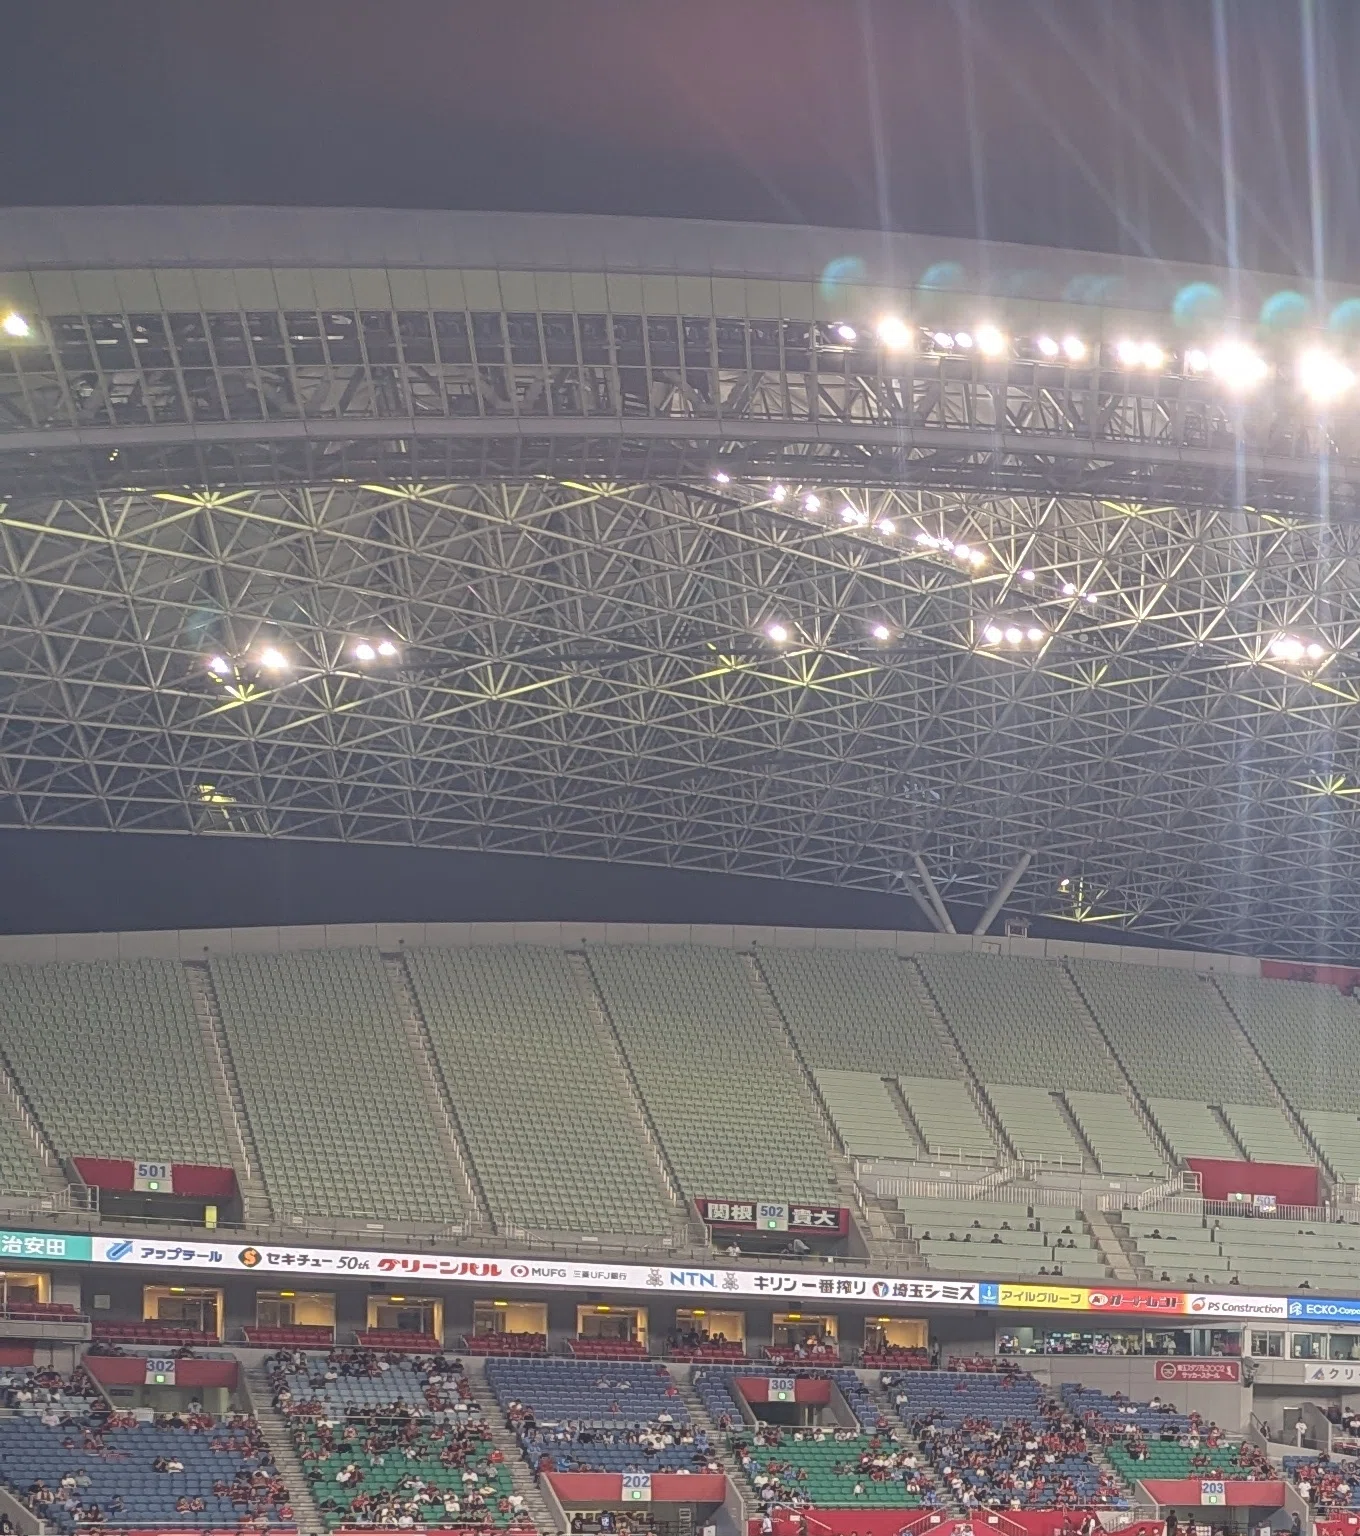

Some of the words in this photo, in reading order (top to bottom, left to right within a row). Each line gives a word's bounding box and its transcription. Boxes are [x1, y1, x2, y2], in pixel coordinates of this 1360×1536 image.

[138, 1164, 167, 1178] 501
[760, 1205, 785, 1218] 502
[0, 1235, 66, 1256] 治安田
[140, 1246, 223, 1264] アップテール
[266, 1252, 333, 1267] セキチュー
[377, 1258, 503, 1277] グリーンパル
[532, 1266, 568, 1278] MUFG
[670, 1272, 716, 1287] NTN
[892, 1283, 976, 1301] 埼玉シミズ
[1001, 1289, 1082, 1304] アイルグループ
[1207, 1300, 1220, 1311] PS
[1222, 1302, 1284, 1315] Construction
[146, 1360, 175, 1372] 302
[771, 1379, 794, 1390] 303
[623, 1475, 651, 1488] 202
[1202, 1482, 1224, 1494] 203
